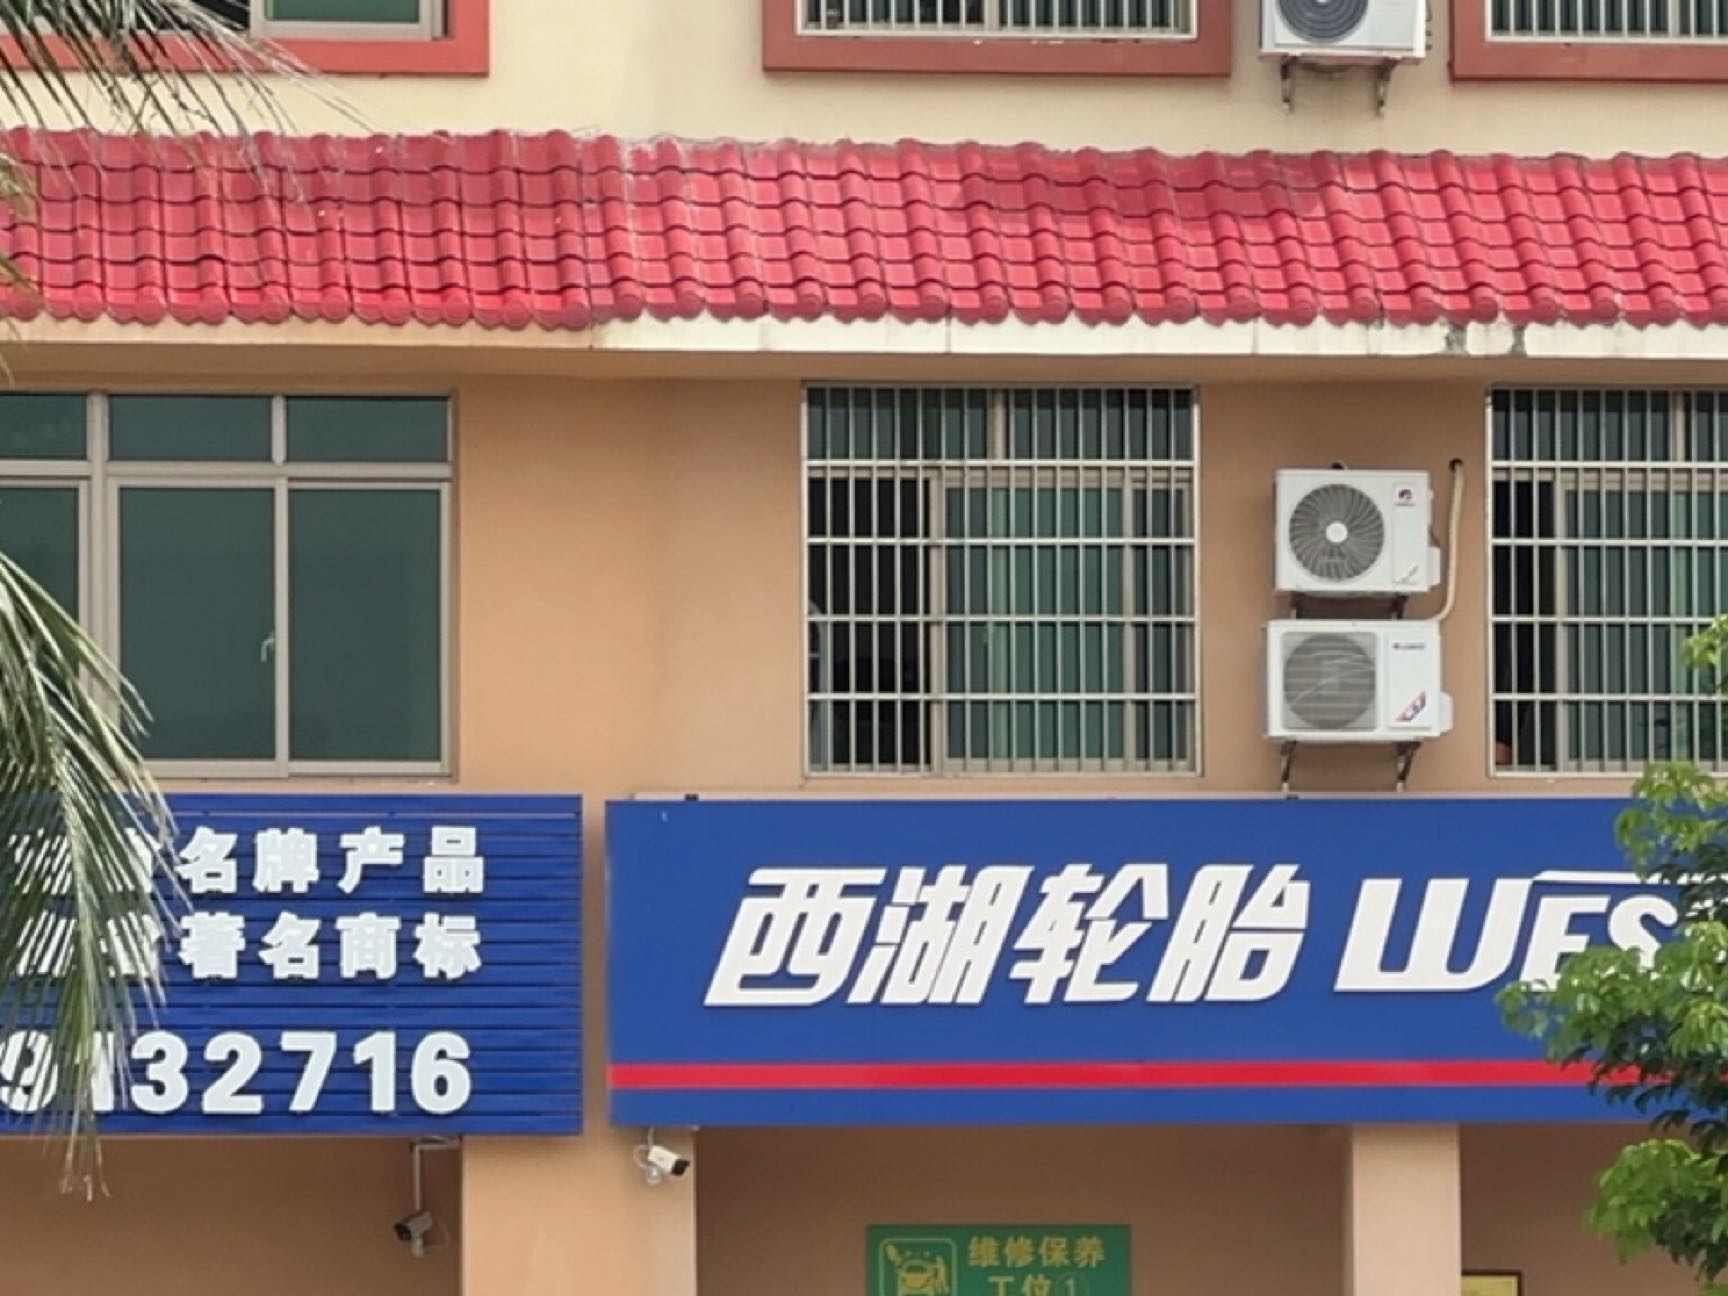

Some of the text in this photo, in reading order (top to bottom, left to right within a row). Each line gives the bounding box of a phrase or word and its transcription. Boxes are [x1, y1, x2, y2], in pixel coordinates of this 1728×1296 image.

[703, 862, 1311, 1006] 西湖轮胎
[968, 1236, 1104, 1268] 维修保养
